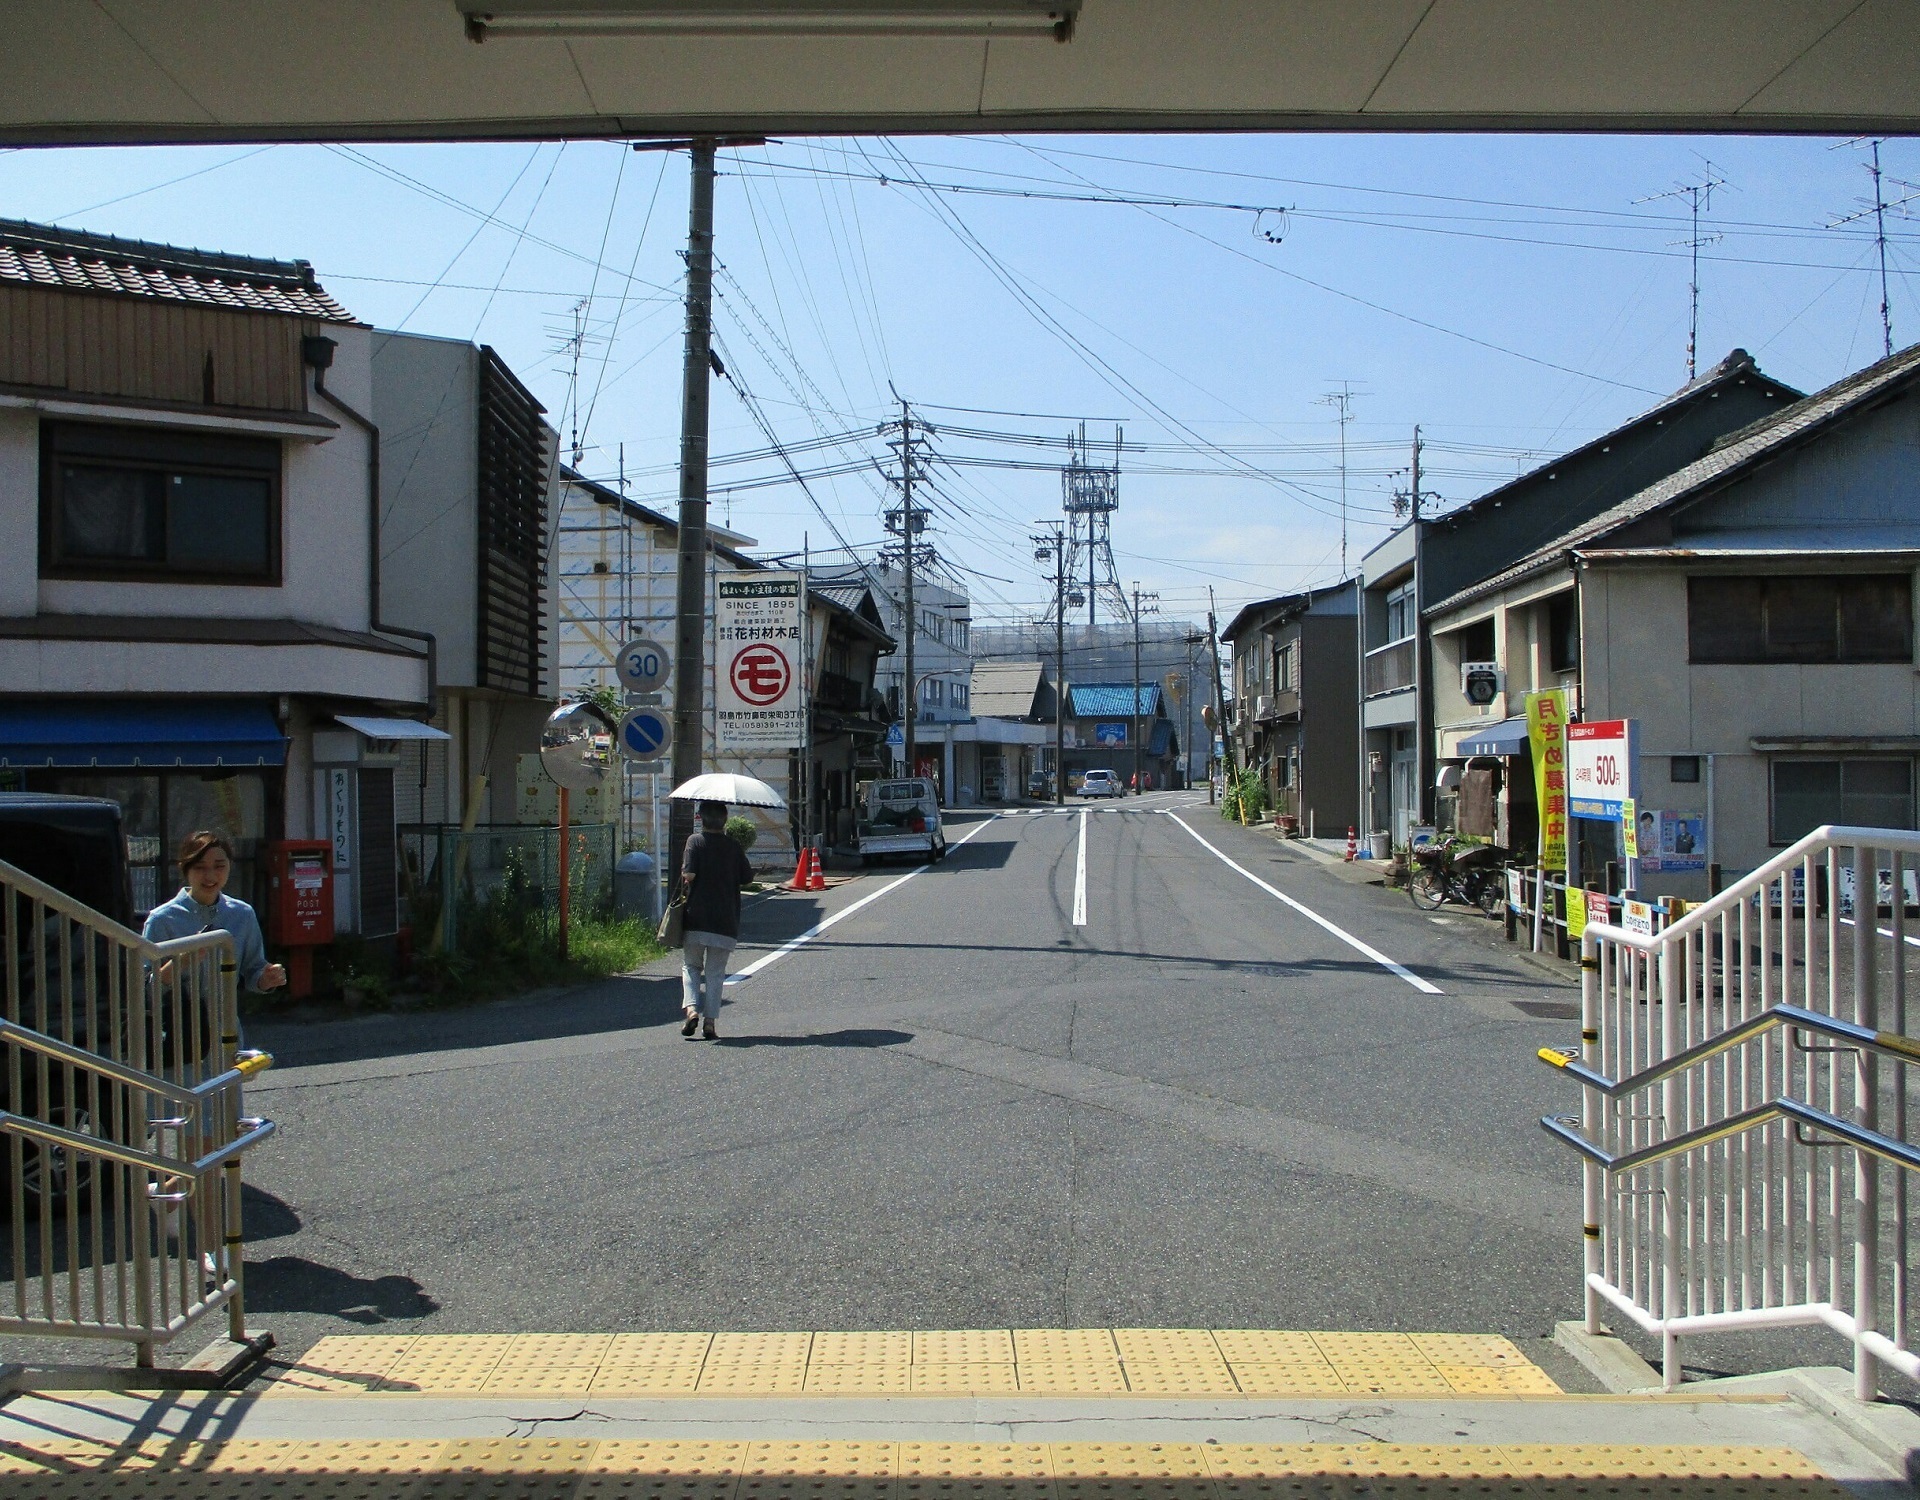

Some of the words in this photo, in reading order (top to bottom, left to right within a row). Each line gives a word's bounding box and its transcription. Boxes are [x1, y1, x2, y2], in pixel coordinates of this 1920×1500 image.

[726, 602, 759, 610] SINCE
[768, 601, 795, 609] 1895
[735, 626, 799, 640] 花村材木店
[629, 654, 658, 678] 30
[297, 899, 319, 908] POST
